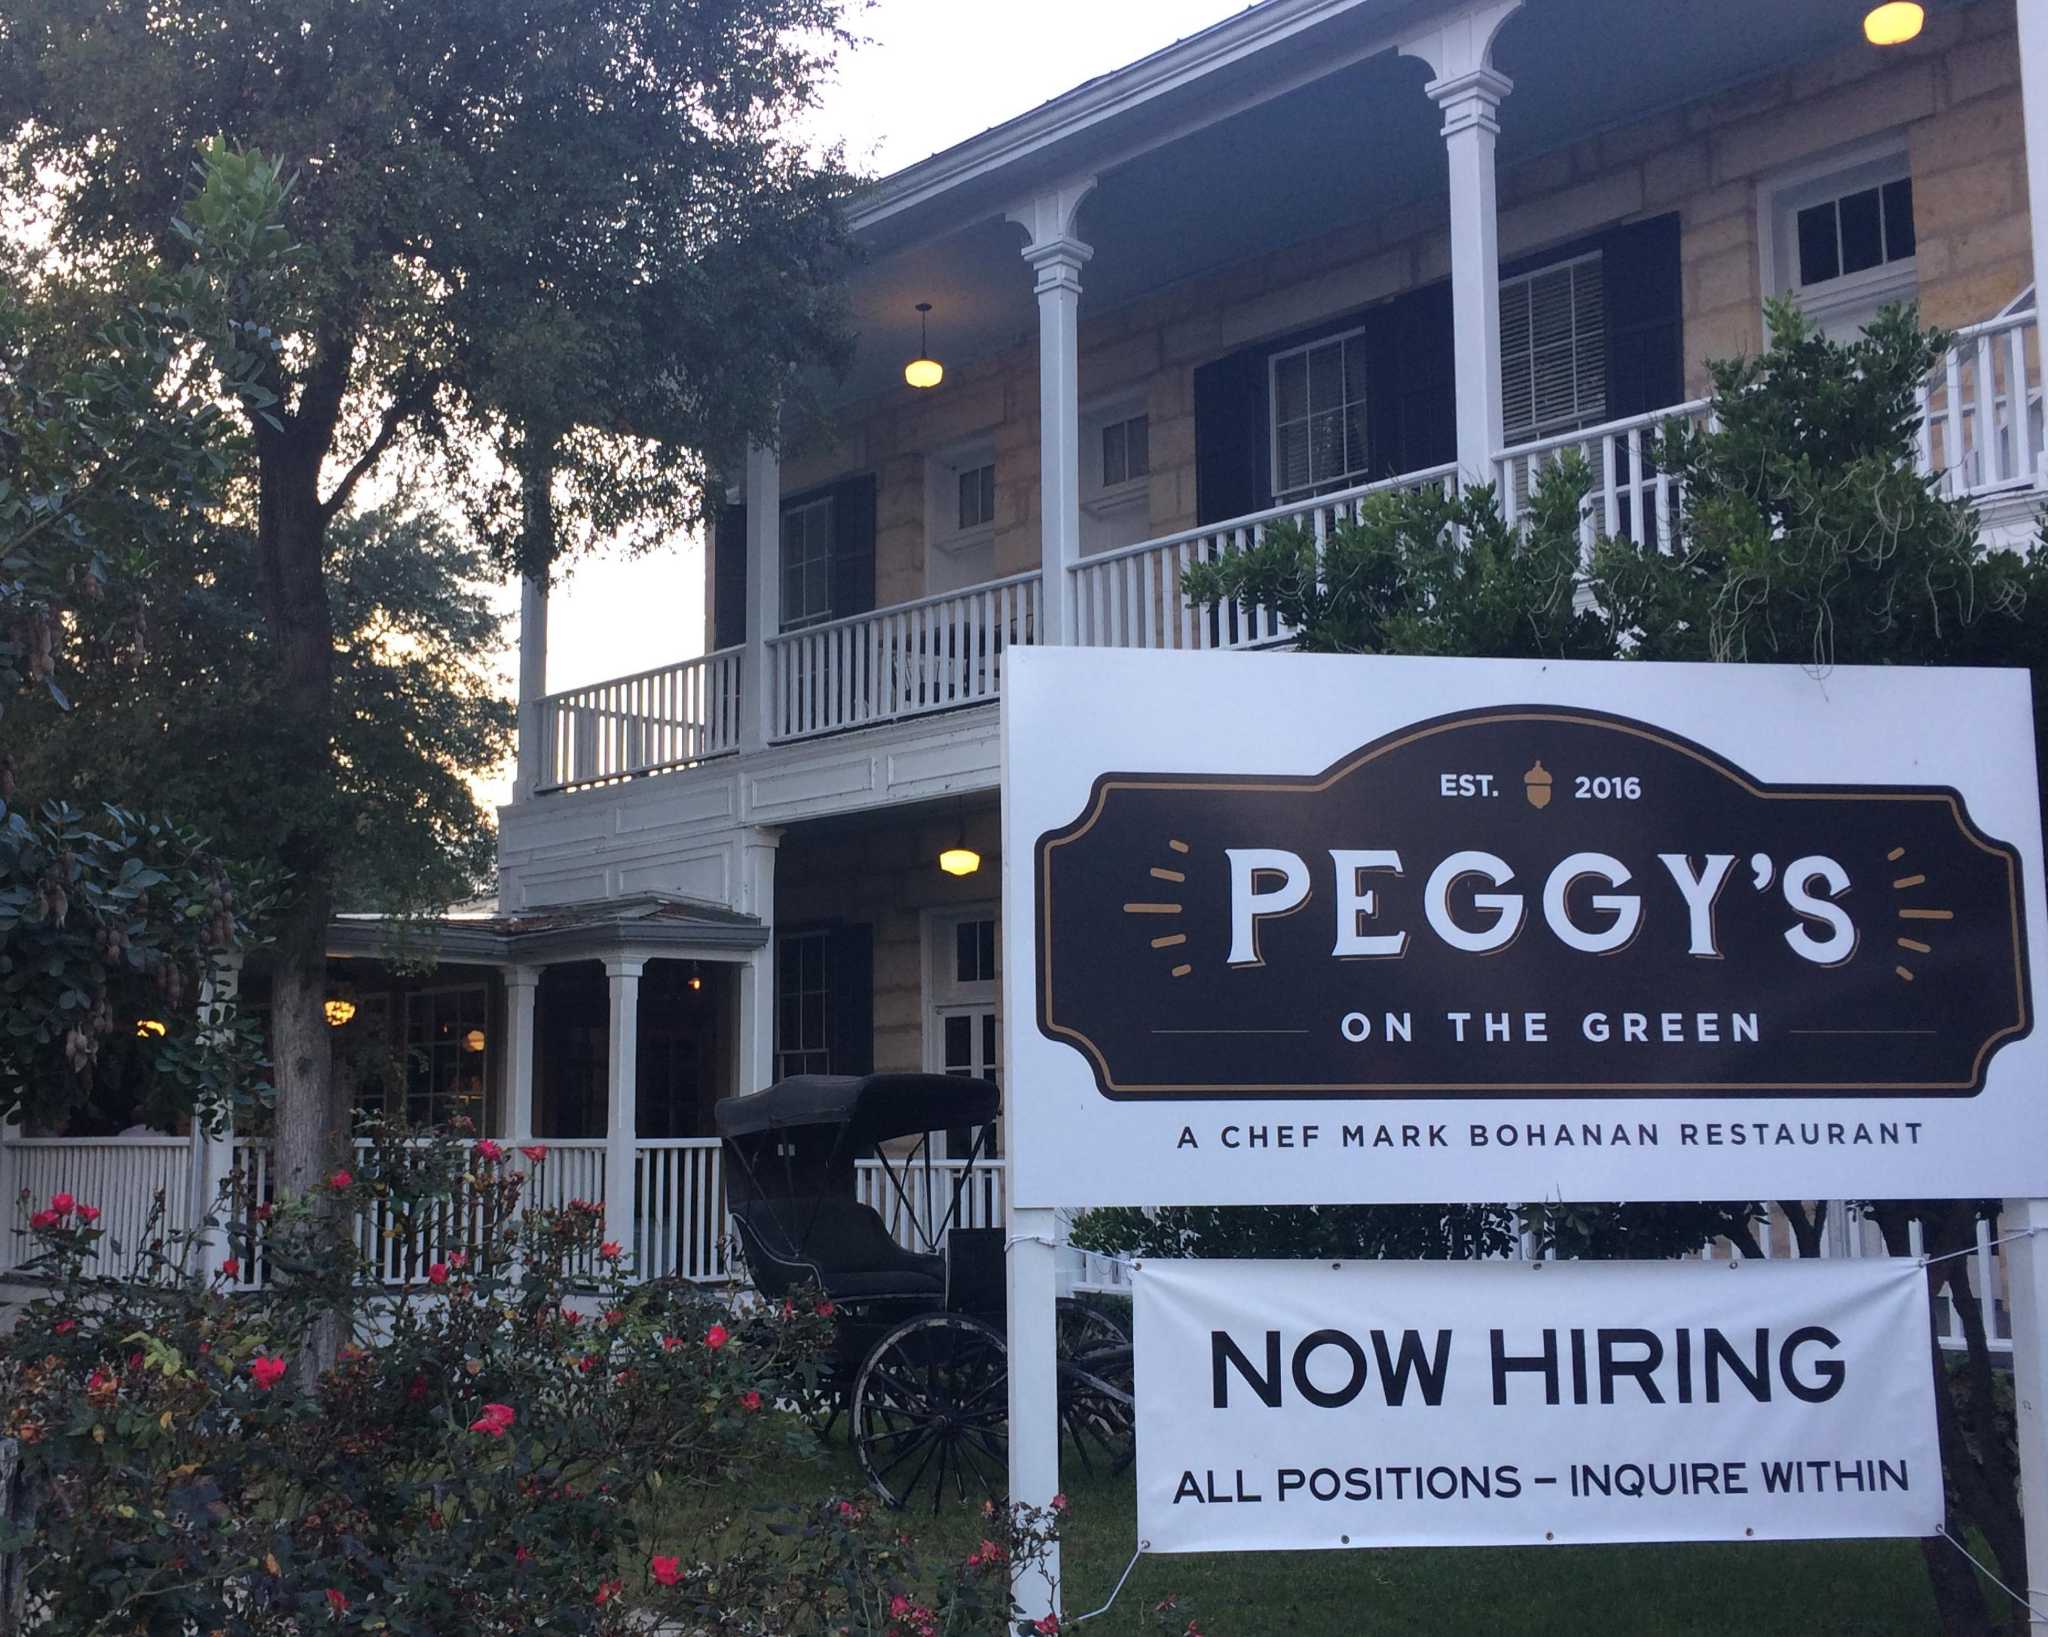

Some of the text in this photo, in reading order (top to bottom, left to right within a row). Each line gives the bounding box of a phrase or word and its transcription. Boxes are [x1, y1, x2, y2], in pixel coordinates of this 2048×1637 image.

[1440, 773, 1642, 800] EST. 2016
[1224, 848, 1857, 966] PEGGY'S
[1341, 1012, 1760, 1043] ON THE GREEN
[1176, 1122, 1924, 1149] A CHEF MARK BOHANAN RESTAURANT
[1211, 1325, 1846, 1409] NOW HIRING
[1172, 1469, 1262, 1505] ALL
[1277, 1465, 1522, 1503] POSITIONS
[1570, 1462, 1749, 1499] INQUIRE
[1760, 1459, 1909, 1495] WITHIN
